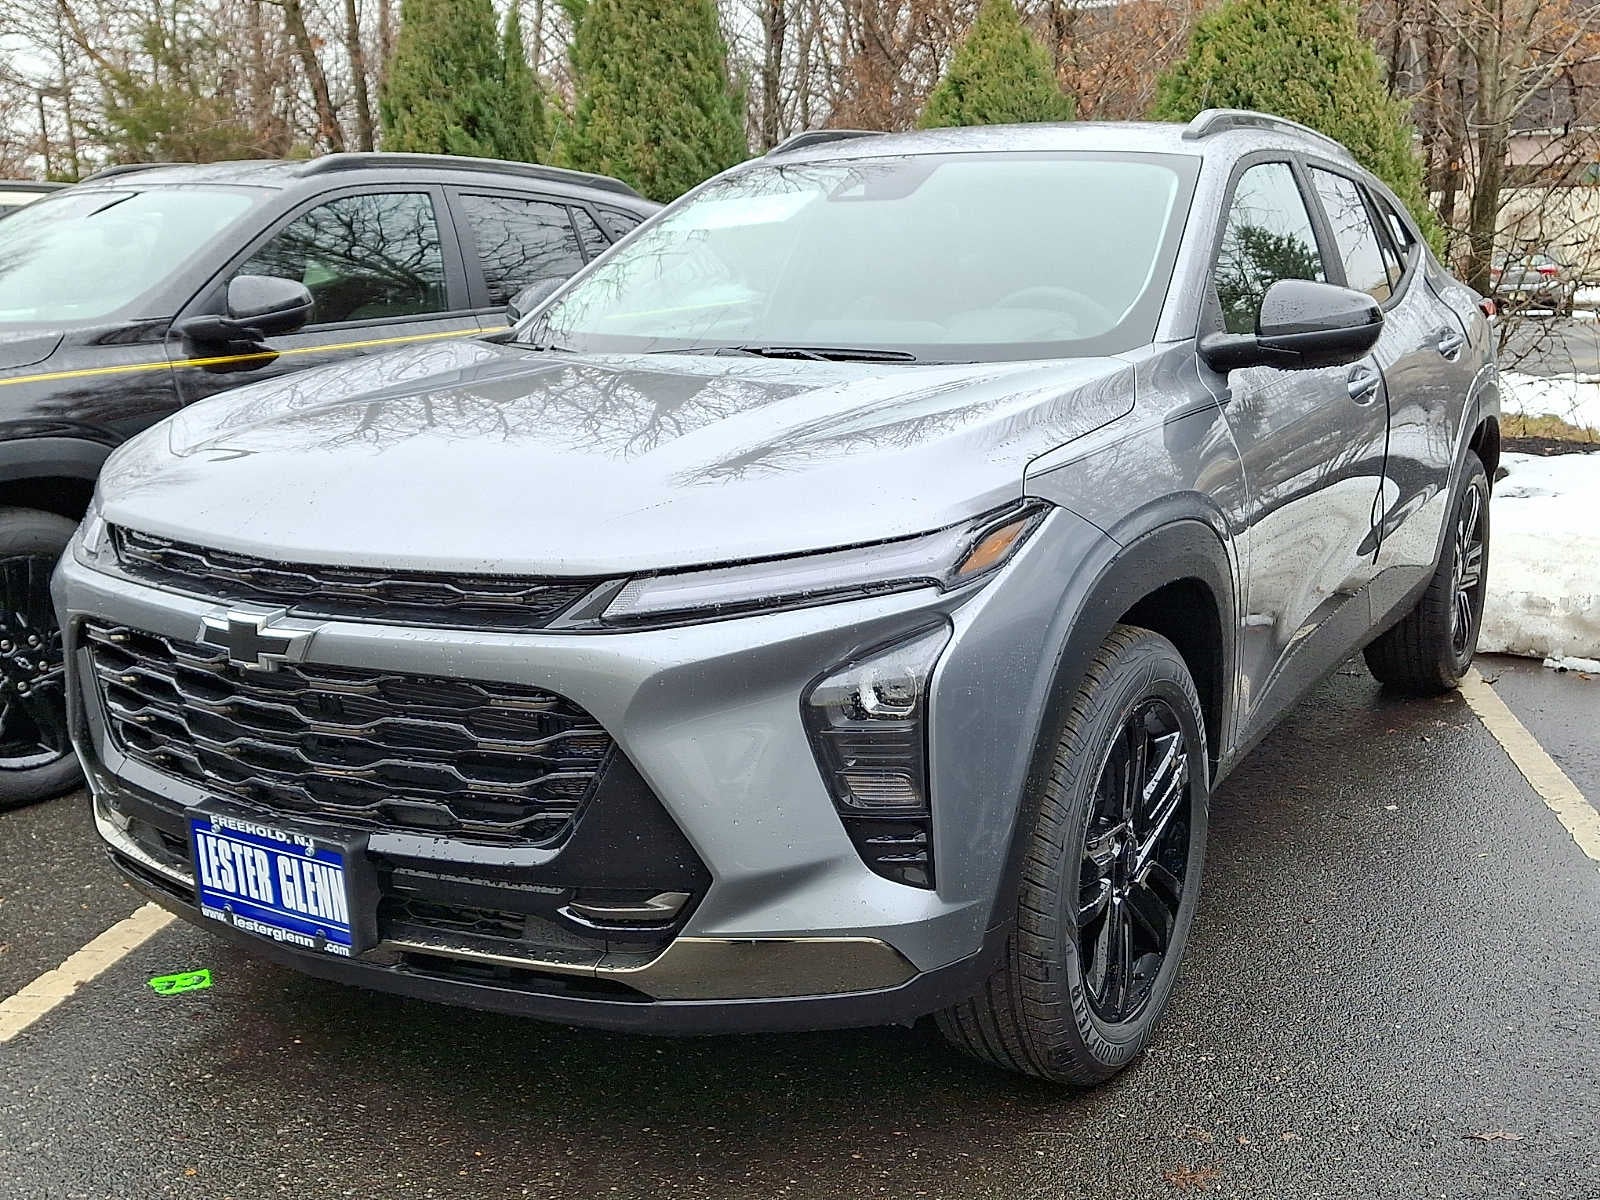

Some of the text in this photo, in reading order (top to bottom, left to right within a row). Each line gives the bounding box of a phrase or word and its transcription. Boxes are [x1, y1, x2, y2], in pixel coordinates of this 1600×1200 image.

[209, 815, 315, 849] FREEHOLD, NJ
[196, 833, 350, 925] LESTER GLENN
[233, 914, 315, 948] lesterglenn
